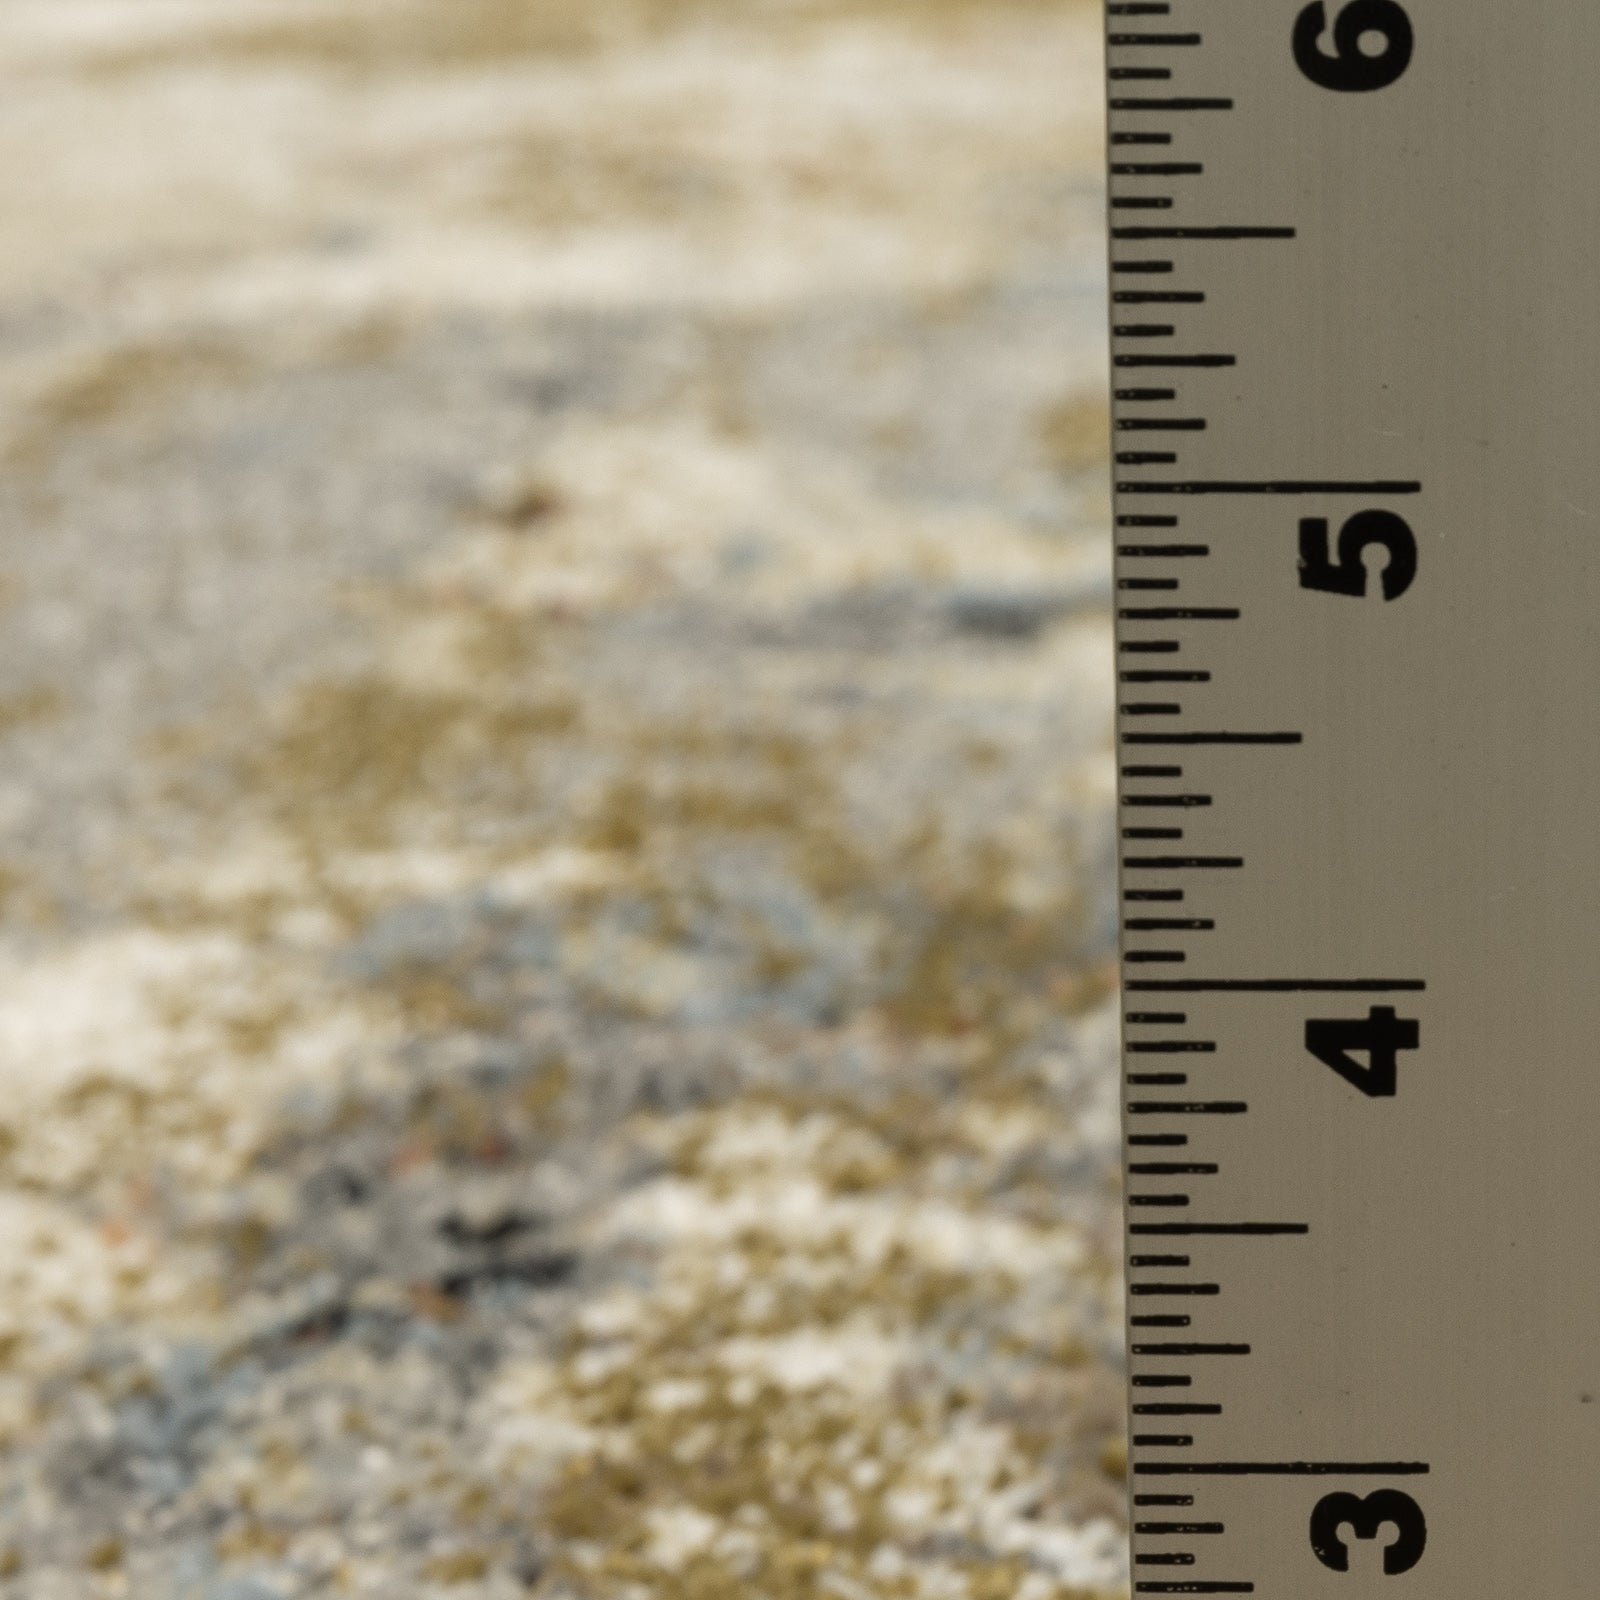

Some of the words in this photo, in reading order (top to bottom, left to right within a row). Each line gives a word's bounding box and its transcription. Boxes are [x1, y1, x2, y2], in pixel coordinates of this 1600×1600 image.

[1291, 0, 1414, 93] 6
[1297, 509, 1418, 602] 5
[1304, 1005, 1420, 1098] 4
[1309, 1488, 1428, 1576] 3
